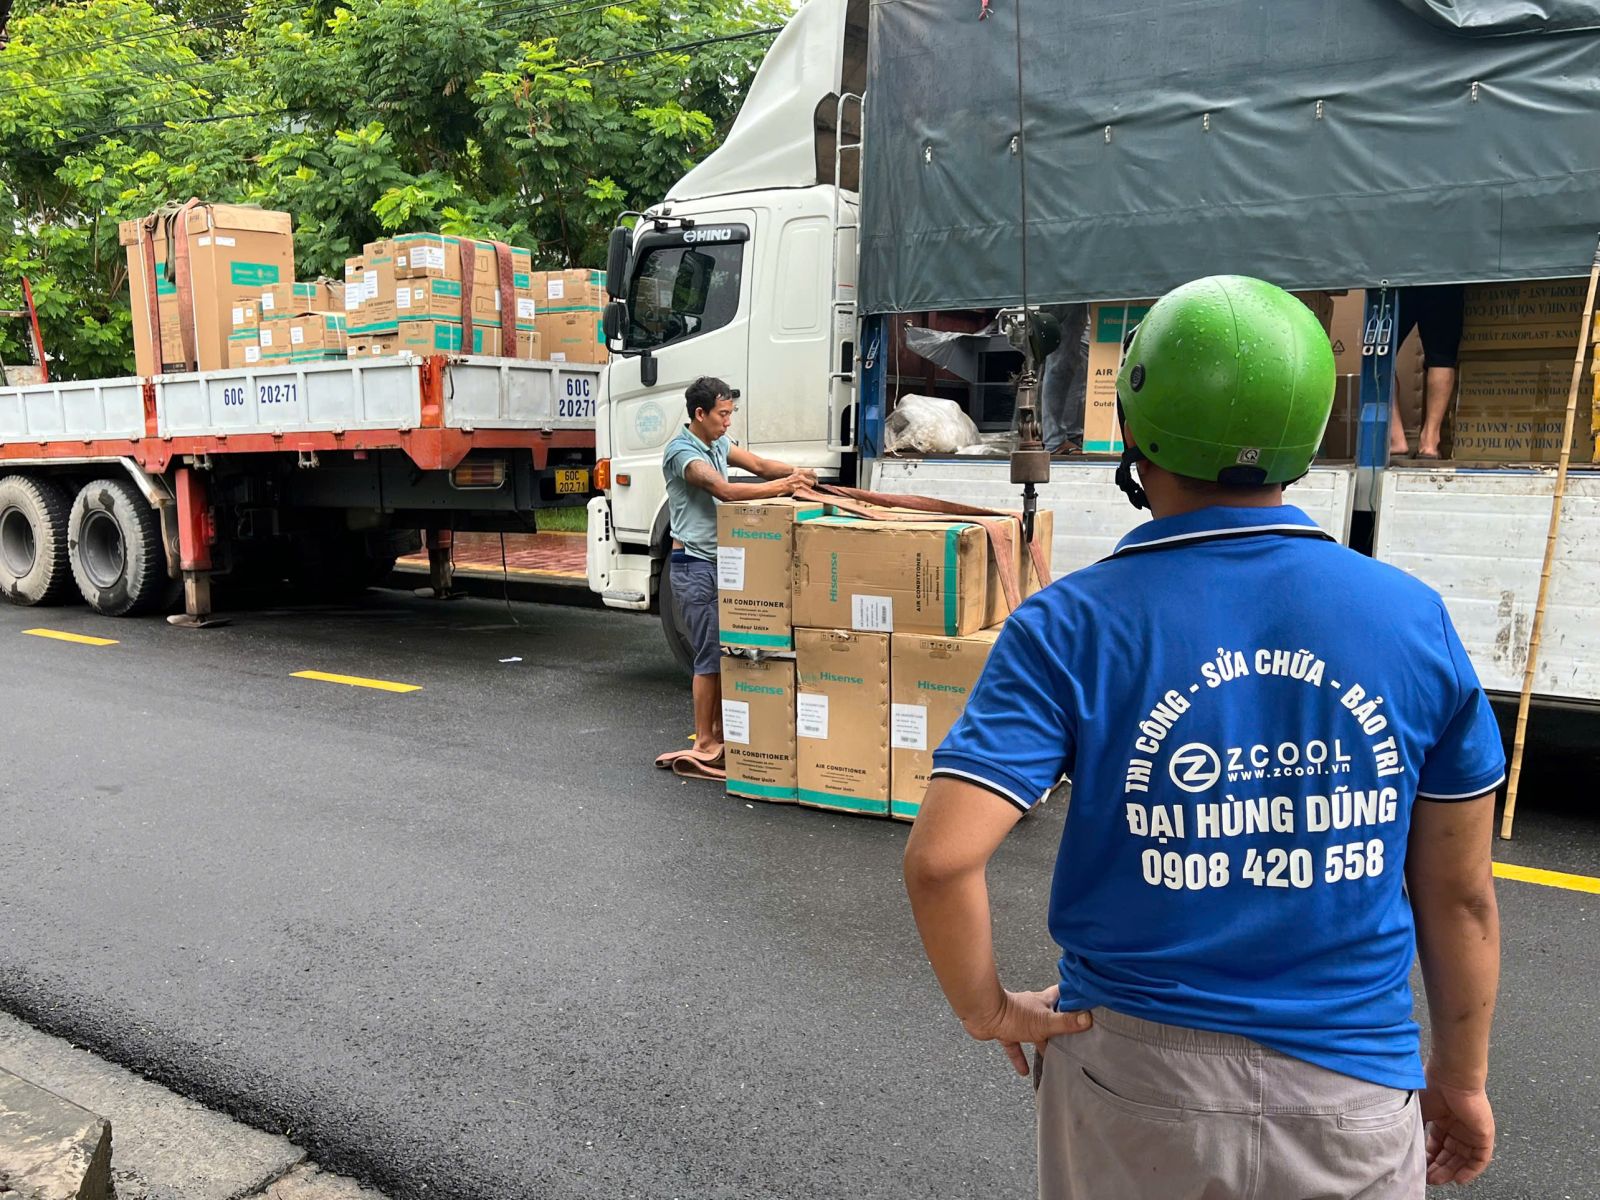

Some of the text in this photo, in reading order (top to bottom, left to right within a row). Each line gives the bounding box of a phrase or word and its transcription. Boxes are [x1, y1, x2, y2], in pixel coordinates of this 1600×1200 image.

[697, 228, 732, 242] HINO
[566, 378, 590, 396] 60C
[224, 388, 244, 406] 60C
[1477, 422, 1507, 433] KNAVI
[564, 470, 580, 481] 60C
[731, 527, 783, 541] Hisense
[829, 551, 838, 603] Hisense
[734, 598, 785, 609] CONDITIONER
[1200, 647, 1250, 688] SỬA
[1255, 648, 1326, 687] CHỮA
[820, 671, 864, 685] Hisense
[917, 680, 966, 694] Hisense
[735, 681, 784, 696] Hisense
[1340, 683, 1389, 736] BẢO
[1135, 689, 1192, 754] CÔNG
[730, 748, 790, 761] AIR CONDITIONER
[1227, 739, 1352, 771] ZCOOL
[1372, 735, 1405, 778] TRÌ
[826, 764, 867, 775] CONDITIONER
[1125, 758, 1153, 793] THI
[1228, 763, 1350, 782] www.zcool.vn
[1126, 785, 1398, 844] ĐẠI HÙNG DŨNG
[1141, 838, 1385, 890] 0908 420 558
